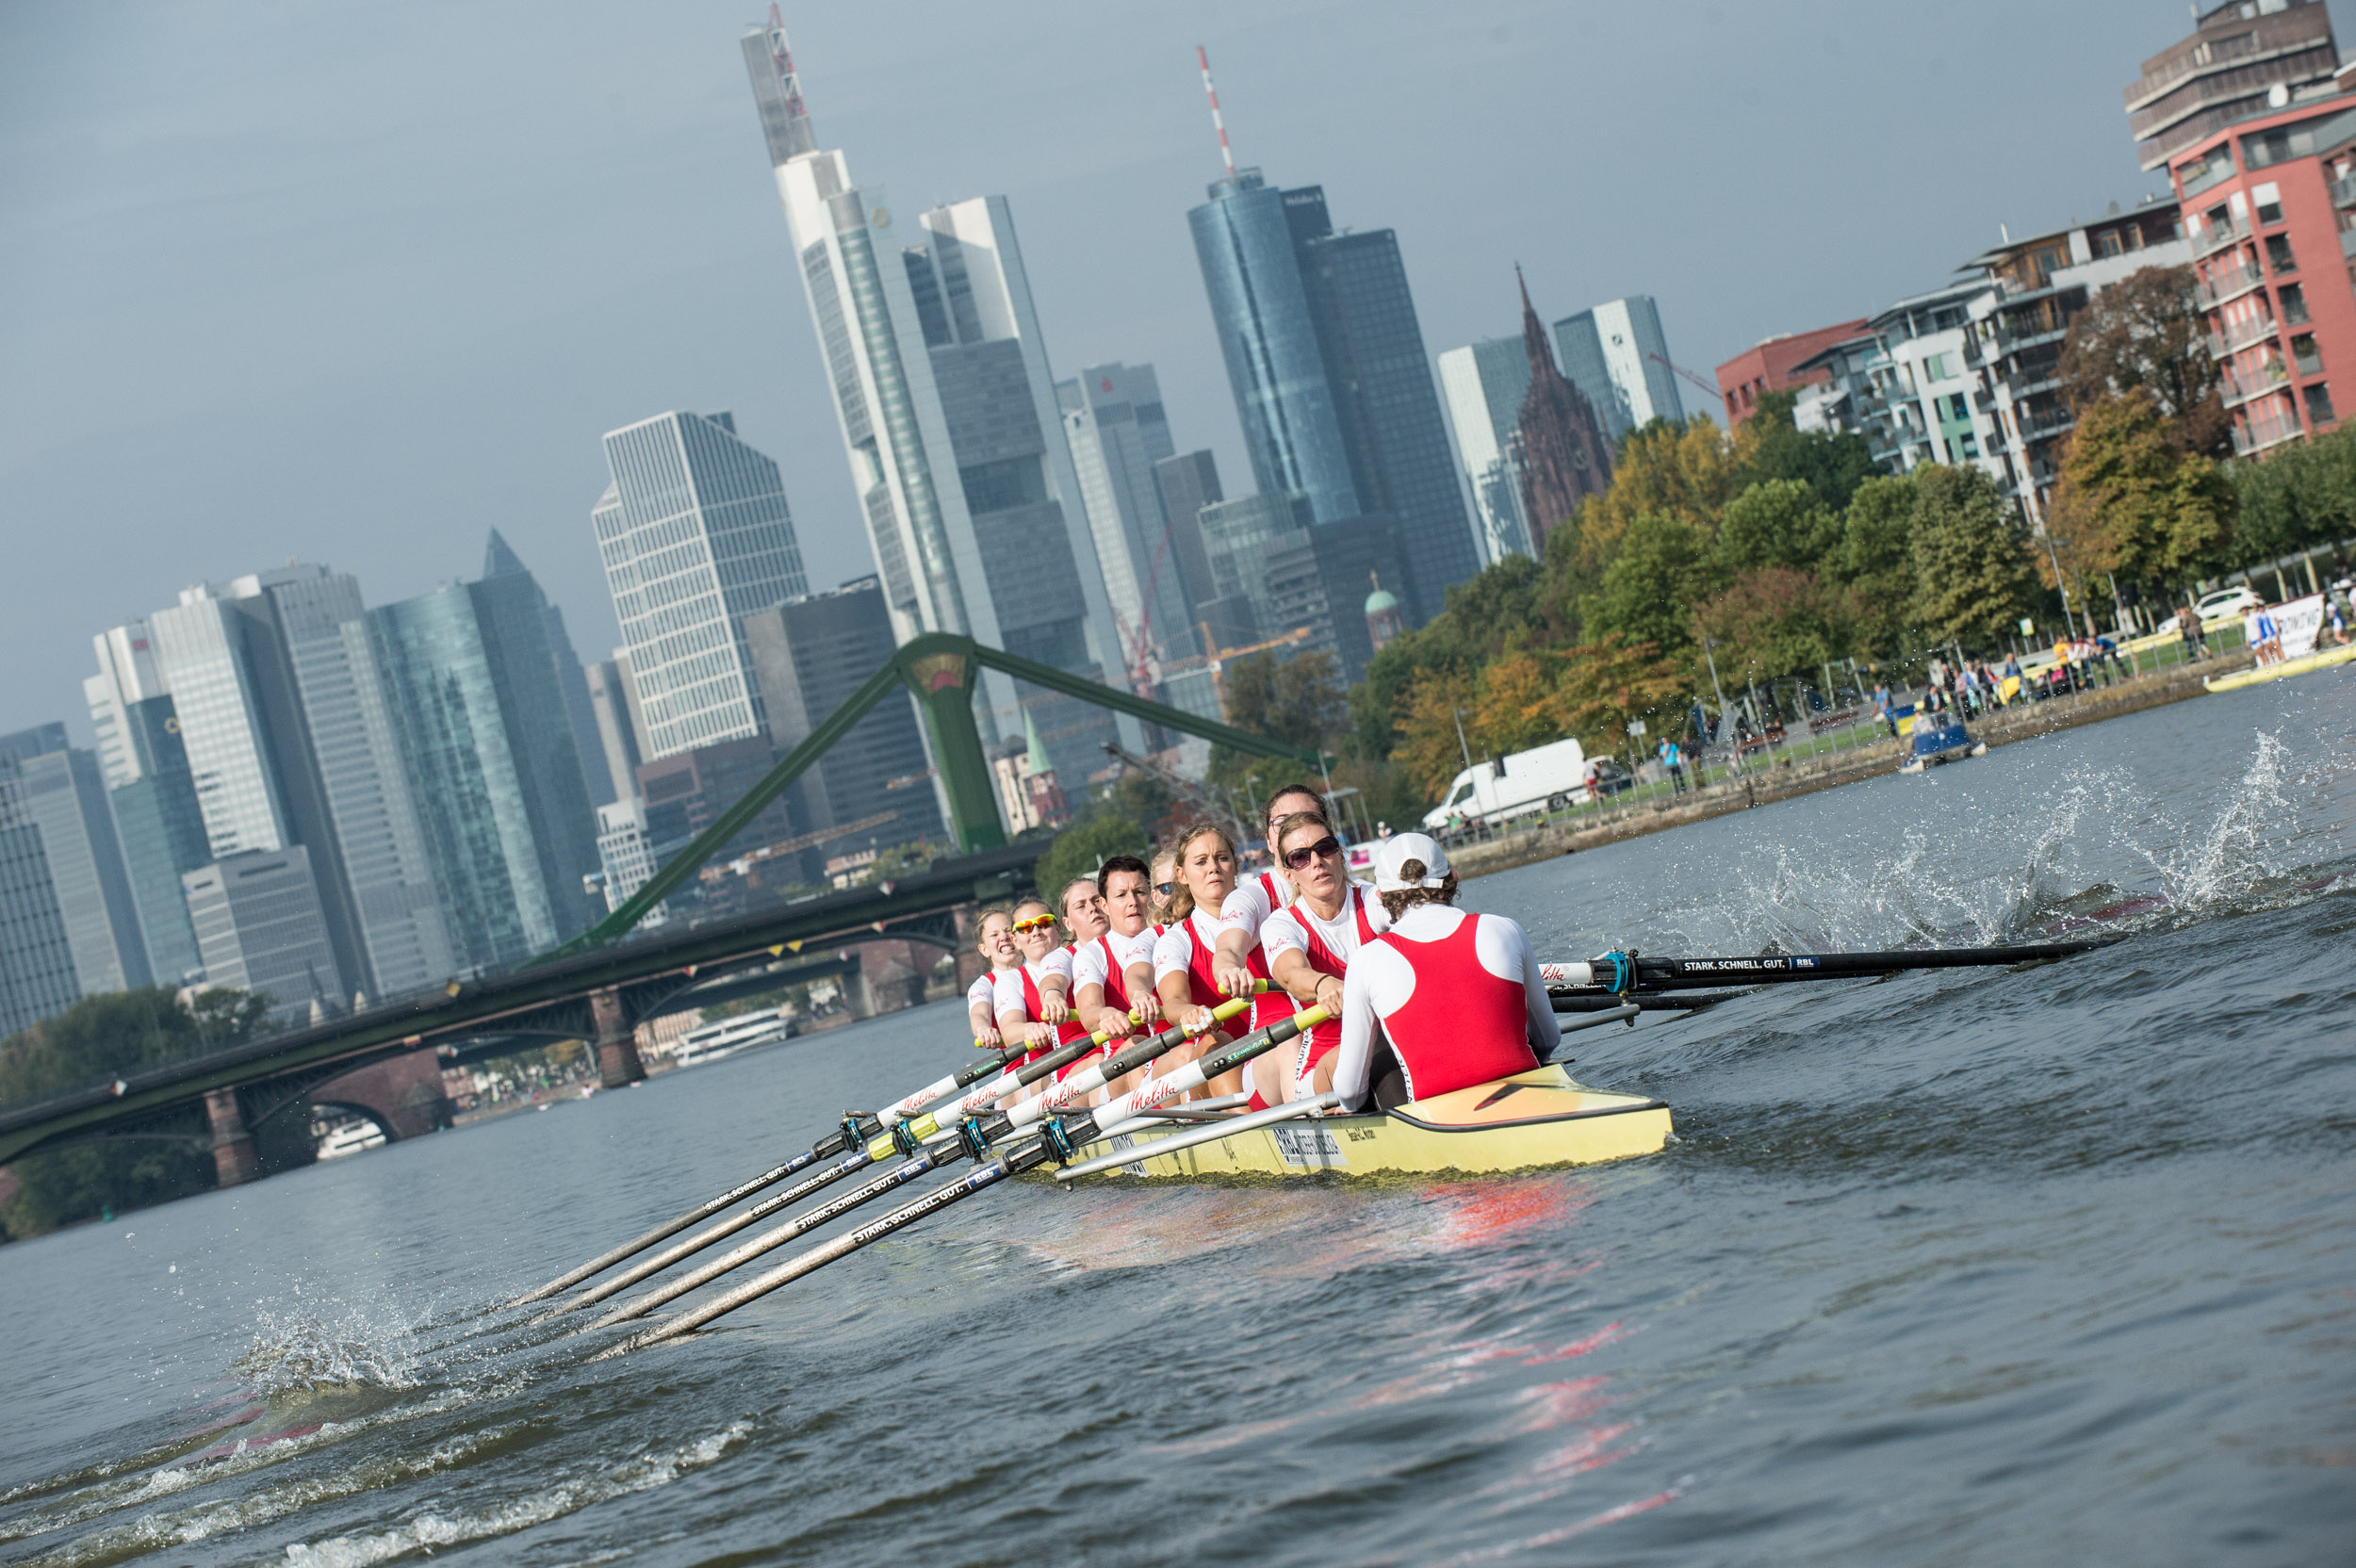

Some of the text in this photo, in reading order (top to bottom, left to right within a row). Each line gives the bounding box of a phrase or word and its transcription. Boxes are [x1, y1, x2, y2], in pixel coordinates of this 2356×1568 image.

[1684, 959, 1786, 972] STARK. SCHNELL. GUT.
[1796, 958, 1815, 967] RBL
[900, 1087, 938, 1111] Melitta
[957, 1085, 1000, 1114] Melitta
[1038, 1083, 1083, 1117] Melitta
[1125, 1079, 1179, 1117] Melitta
[706, 1166, 784, 1210] STARK. SCHNELL. GUT.
[753, 1167, 839, 1215] STARK. SCHNELL. GUT.
[974, 1169, 994, 1183] RBL
[799, 1175, 895, 1228] STARK. SCHNELL. GUT.
[858, 1184, 963, 1241] STARK. SCHNELL. GUT.
